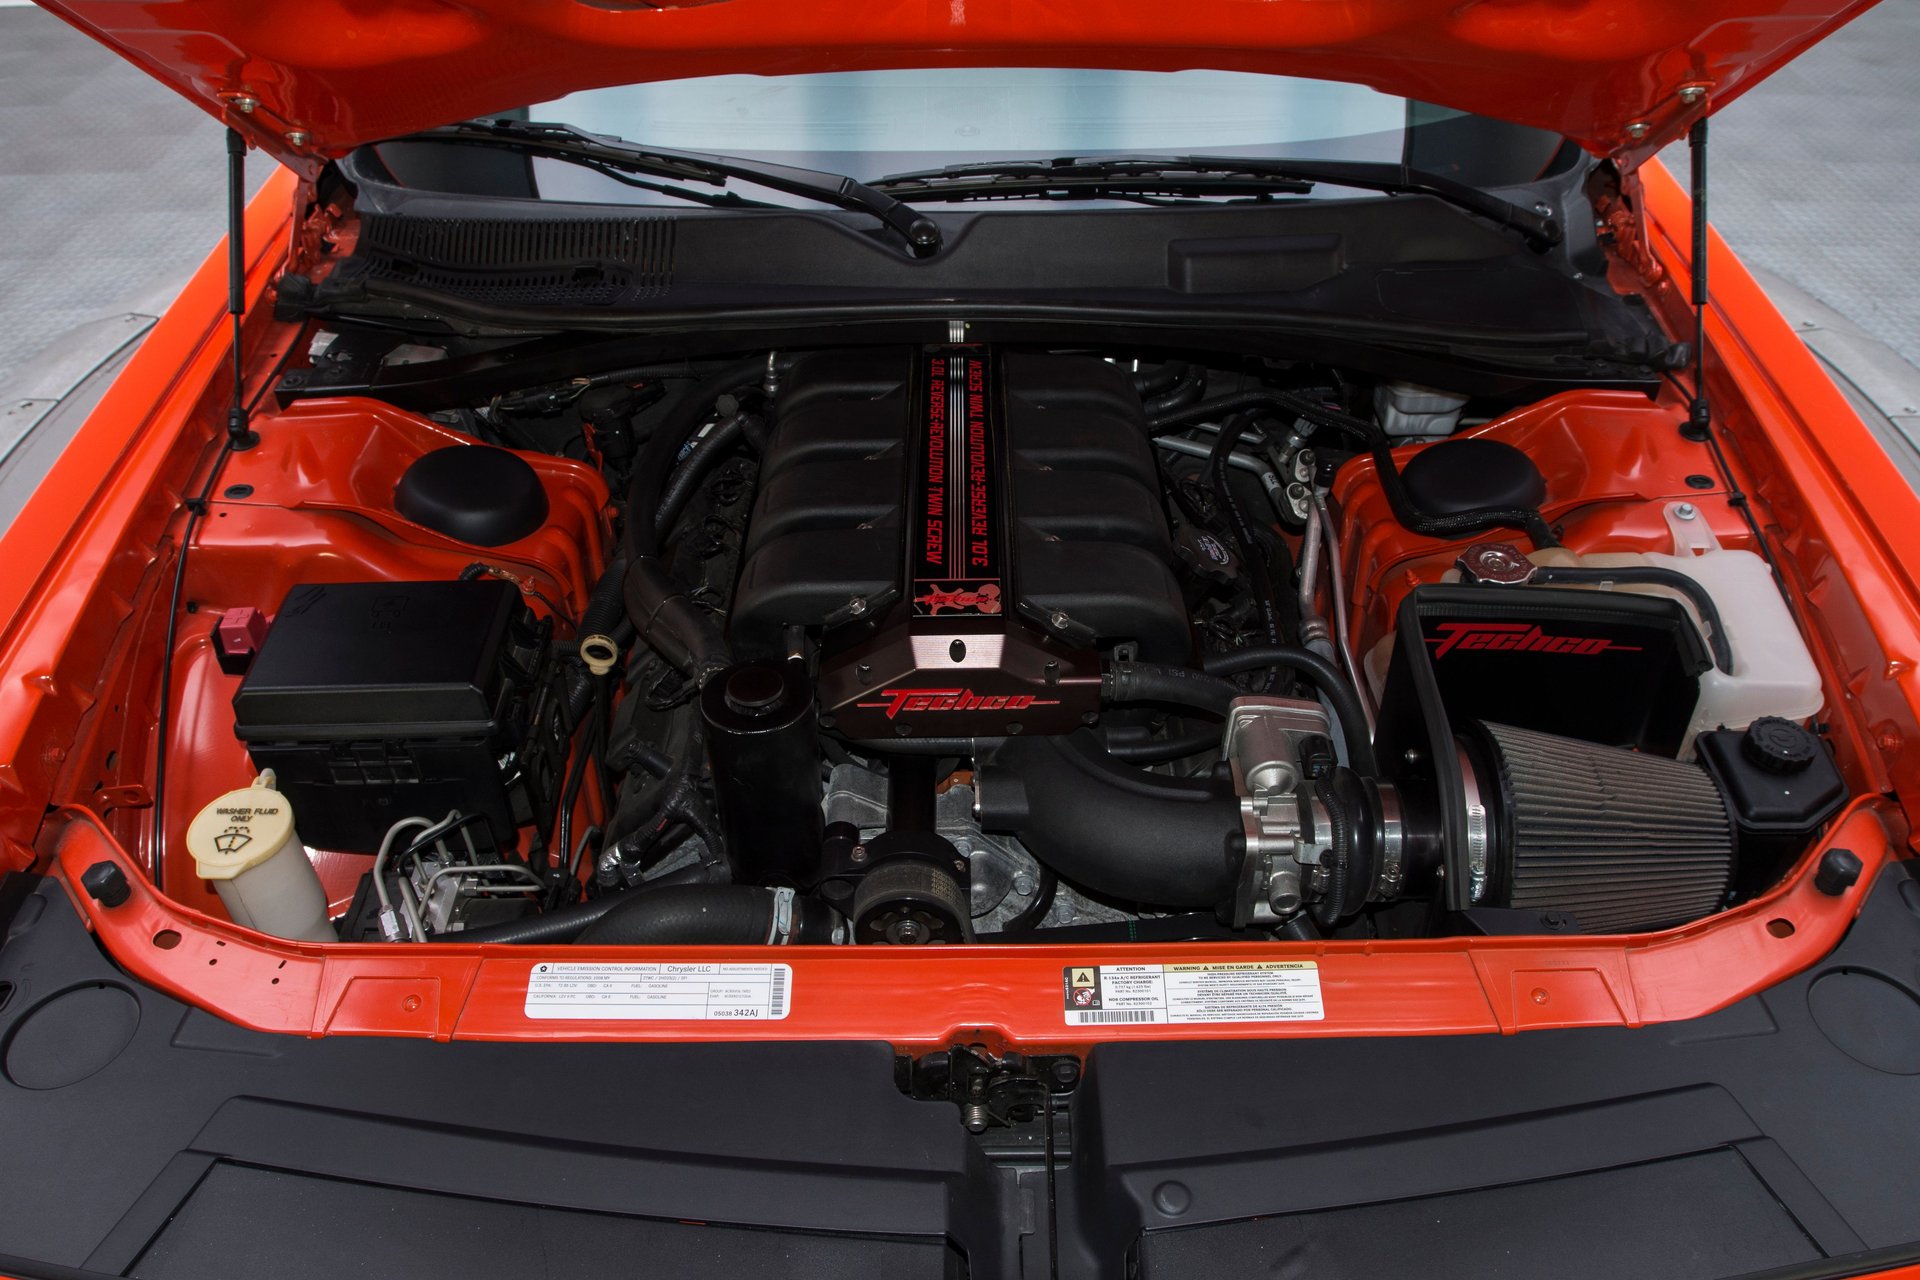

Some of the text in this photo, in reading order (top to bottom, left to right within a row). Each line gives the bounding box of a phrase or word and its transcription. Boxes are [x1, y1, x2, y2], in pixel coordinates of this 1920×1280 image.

[926, 359, 945, 565] 3.0L REVERSE-REVOLUTION TWIN SCREW
[968, 360, 988, 567] 3.0L REVERSE-REVOLUTION TWIN SCREW
[1435, 623, 1612, 660] Techco
[881, 688, 1036, 720] Techco
[734, 1009, 758, 1017] 342AJ
